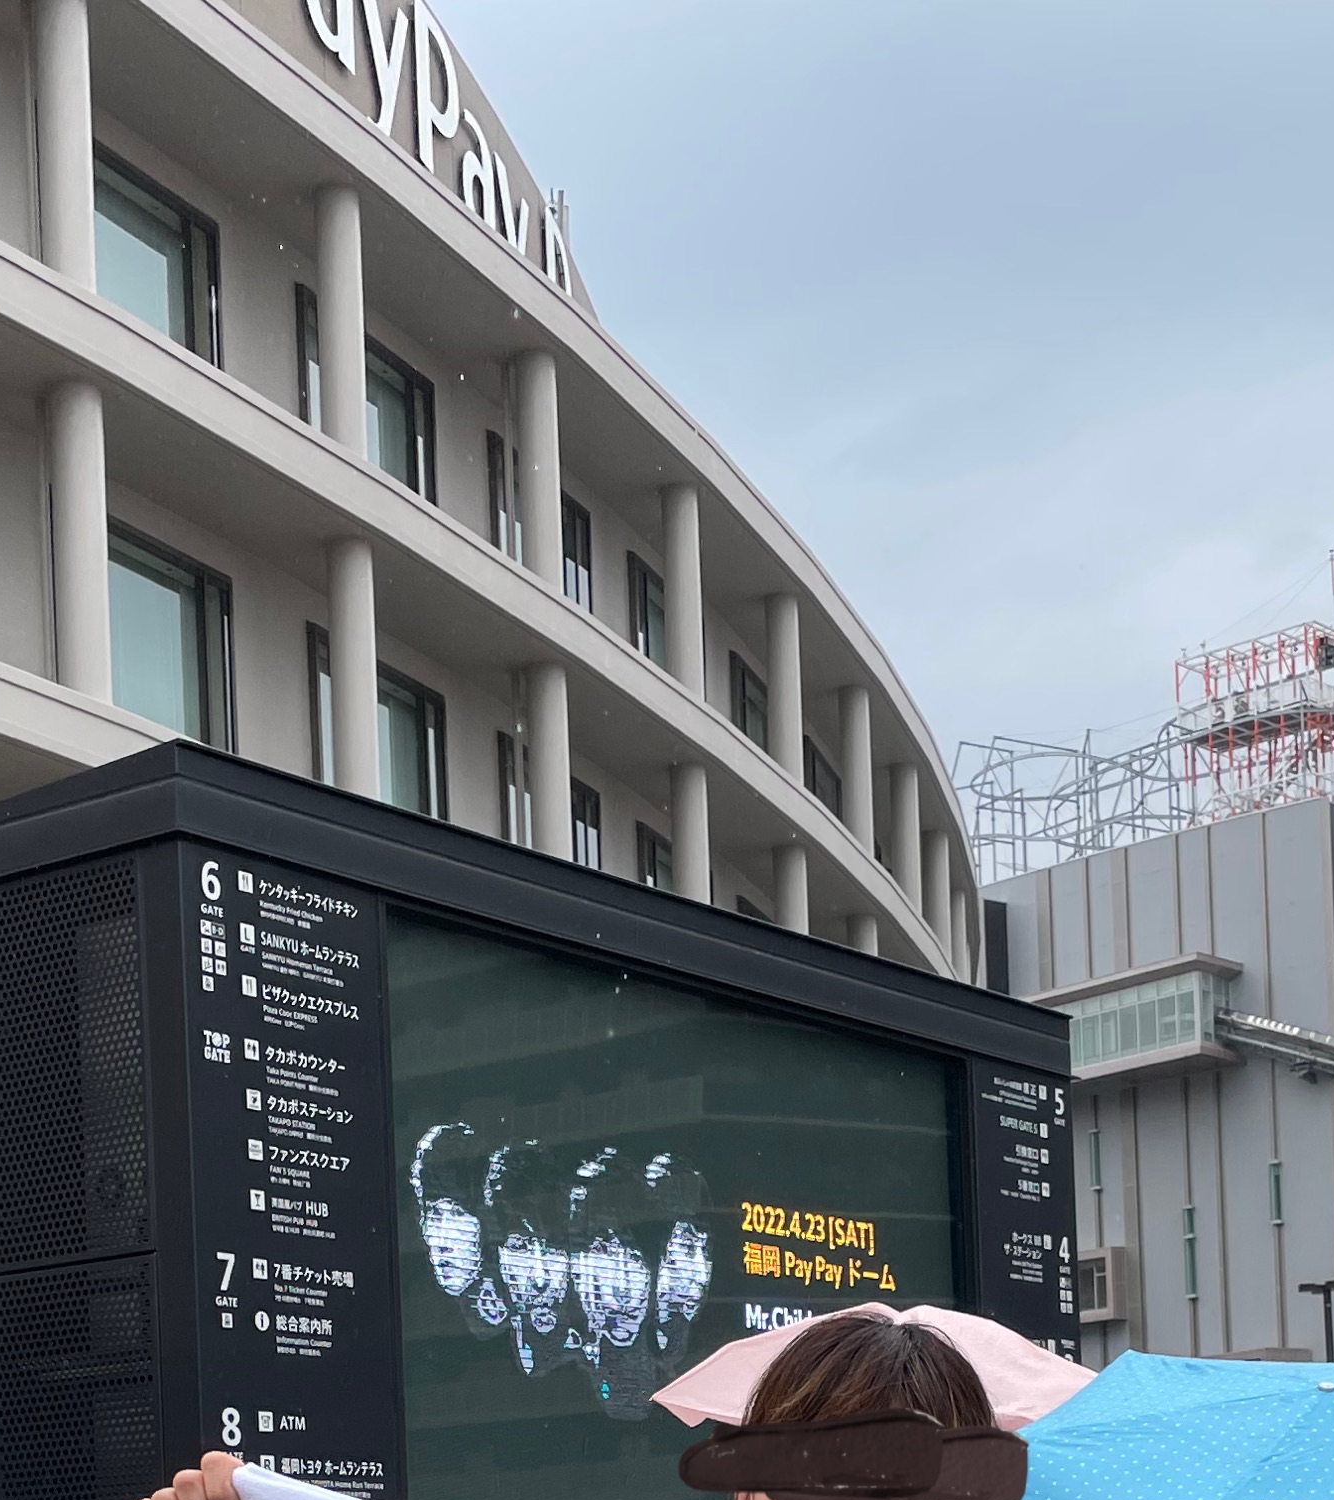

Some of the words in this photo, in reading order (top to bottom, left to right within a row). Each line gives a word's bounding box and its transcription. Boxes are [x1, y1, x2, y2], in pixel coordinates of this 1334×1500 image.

[201, 861, 222, 900] 6
[200, 903, 224, 918] GATE
[259, 880, 358, 918] ケンタッキーフライドチキン
[244, 927, 252, 941] L
[261, 931, 299, 954] SANKYU
[300, 941, 360, 969] ホームランテラス
[262, 983, 359, 1021] ピザクックエクスプレス
[203, 1029, 231, 1049] TOP
[204, 1046, 231, 1063] GATE
[1054, 1088, 1065, 1115] 5
[269, 1146, 350, 1172] ファンズスクエア
[306, 1201, 329, 1217] HUB
[741, 1201, 826, 1242] 2022.4.23
[829, 1216, 875, 1256] [SAT]
[1058, 1237, 1070, 1263] 4
[217, 1252, 235, 1291] 7
[273, 1263, 354, 1288] 7番チケット売場
[743, 1242, 780, 1278] 福岡
[849, 1258, 896, 1292] ドーム
[215, 1296, 238, 1308] GATE
[276, 1314, 333, 1336] 総合案内所
[221, 1407, 242, 1447] 8
[280, 1416, 306, 1431] ATM
[281, 1457, 322, 1475] 福岡トヨタ
[325, 1460, 384, 1477] ホームランテラス
